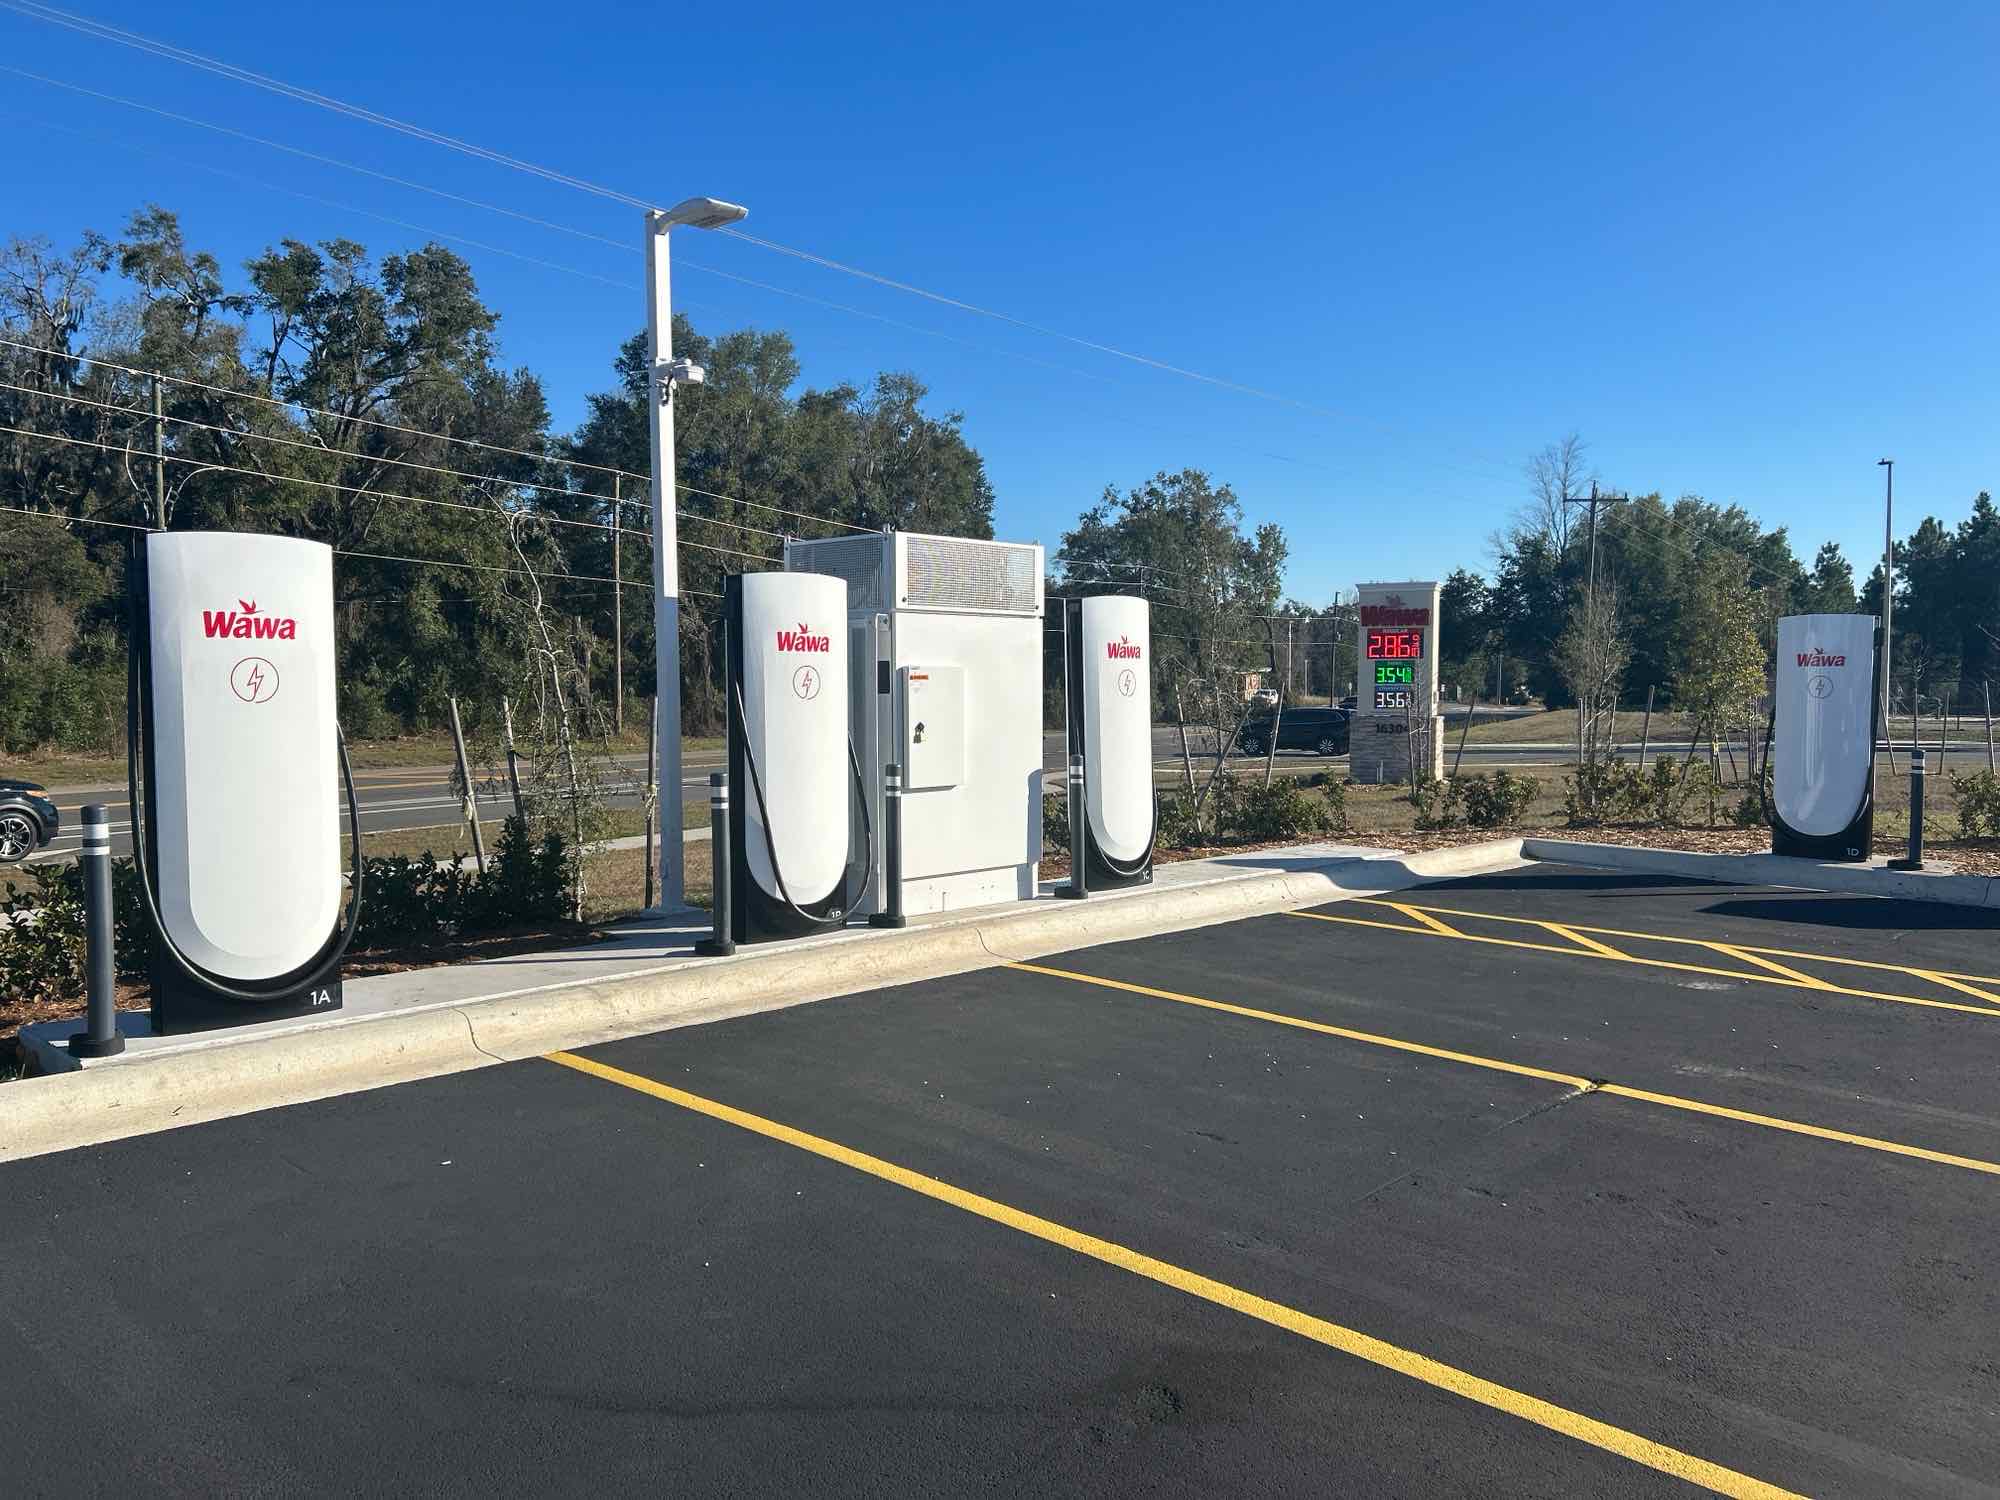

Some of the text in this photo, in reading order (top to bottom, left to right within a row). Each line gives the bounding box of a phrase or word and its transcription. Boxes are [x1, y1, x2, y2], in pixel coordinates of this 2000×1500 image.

[203, 610, 296, 640] Wawa
[777, 632, 829, 653] Wawa
[1107, 642, 1140, 658] Wawa
[1369, 636, 1410, 657] 2.86
[1796, 653, 1846, 667] Wawa
[1377, 667, 1405, 682] 3.54
[1376, 692, 1404, 707] 3.56
[1846, 847, 1859, 857] 1D
[1142, 870, 1149, 880] 1C
[310, 989, 331, 1005] 1A
